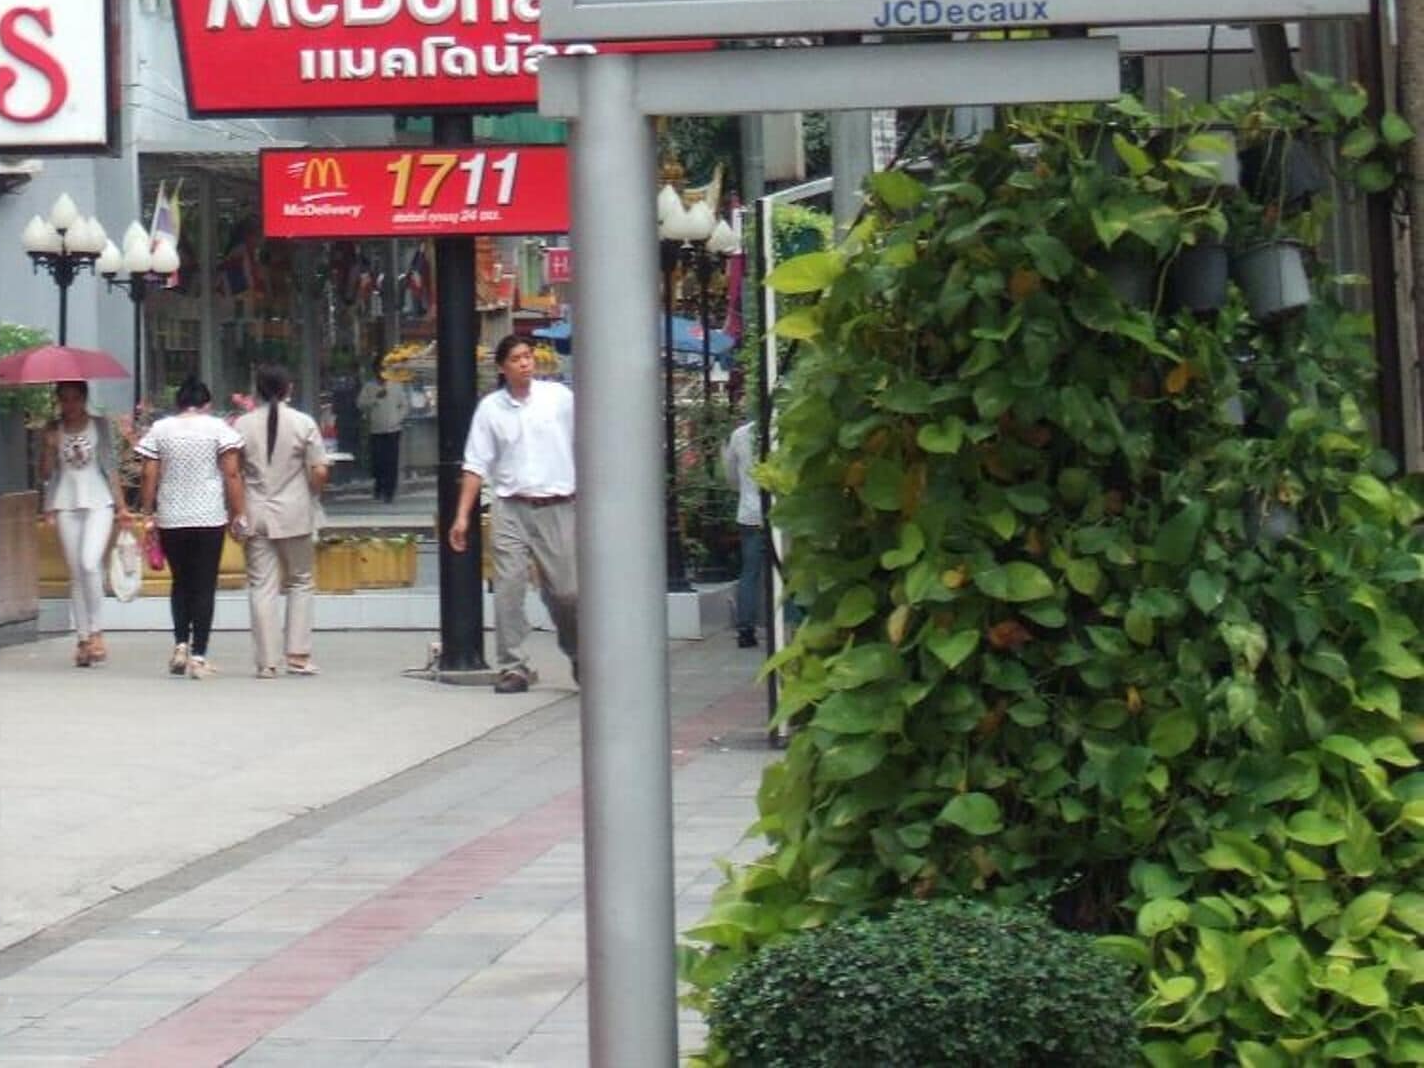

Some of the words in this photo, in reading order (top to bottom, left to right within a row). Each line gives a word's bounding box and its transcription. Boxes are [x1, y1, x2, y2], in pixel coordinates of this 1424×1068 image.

[874, 0, 1049, 28] JCDecaux
[387, 152, 518, 207] 1711
[283, 203, 363, 218] McDelivery
